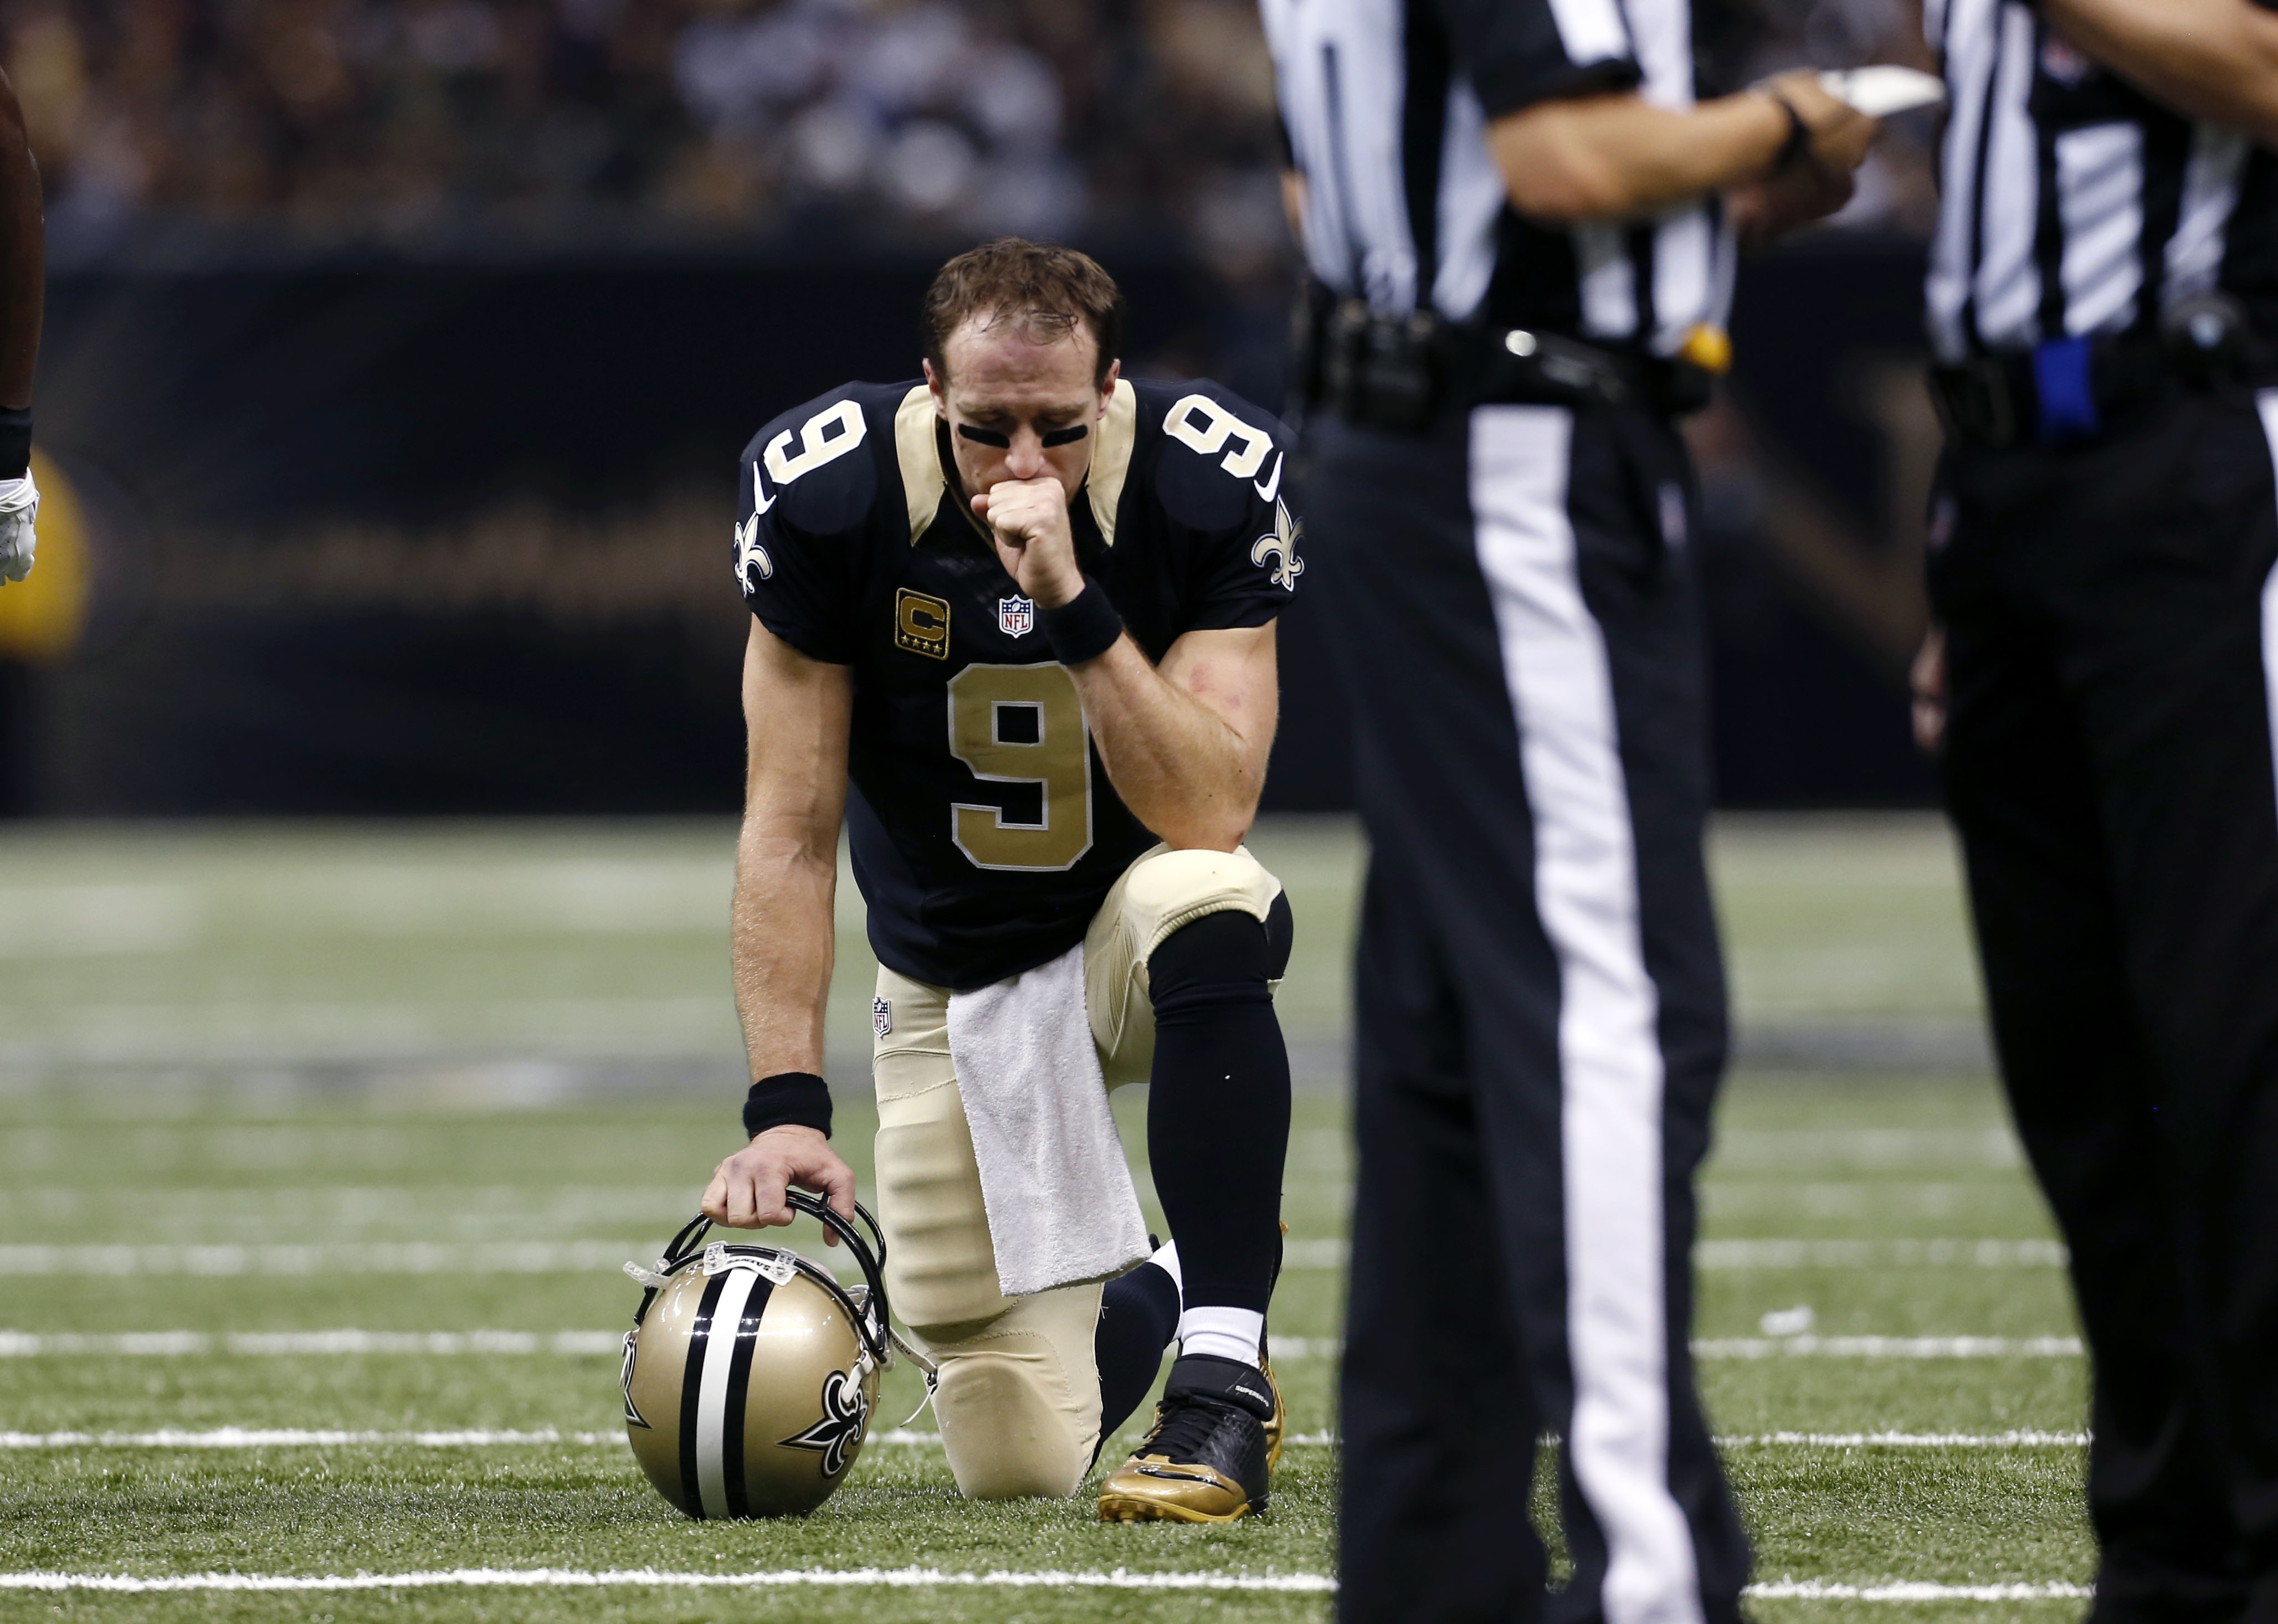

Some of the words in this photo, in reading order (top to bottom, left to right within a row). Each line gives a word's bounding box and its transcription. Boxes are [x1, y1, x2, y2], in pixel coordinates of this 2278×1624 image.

[763, 399, 868, 485] 9
[1162, 394, 1274, 478] 9
[900, 596, 946, 641] C
[1004, 614, 1028, 630] NFL
[947, 661, 1094, 871] 9
[874, 1014, 887, 1030] NFL
